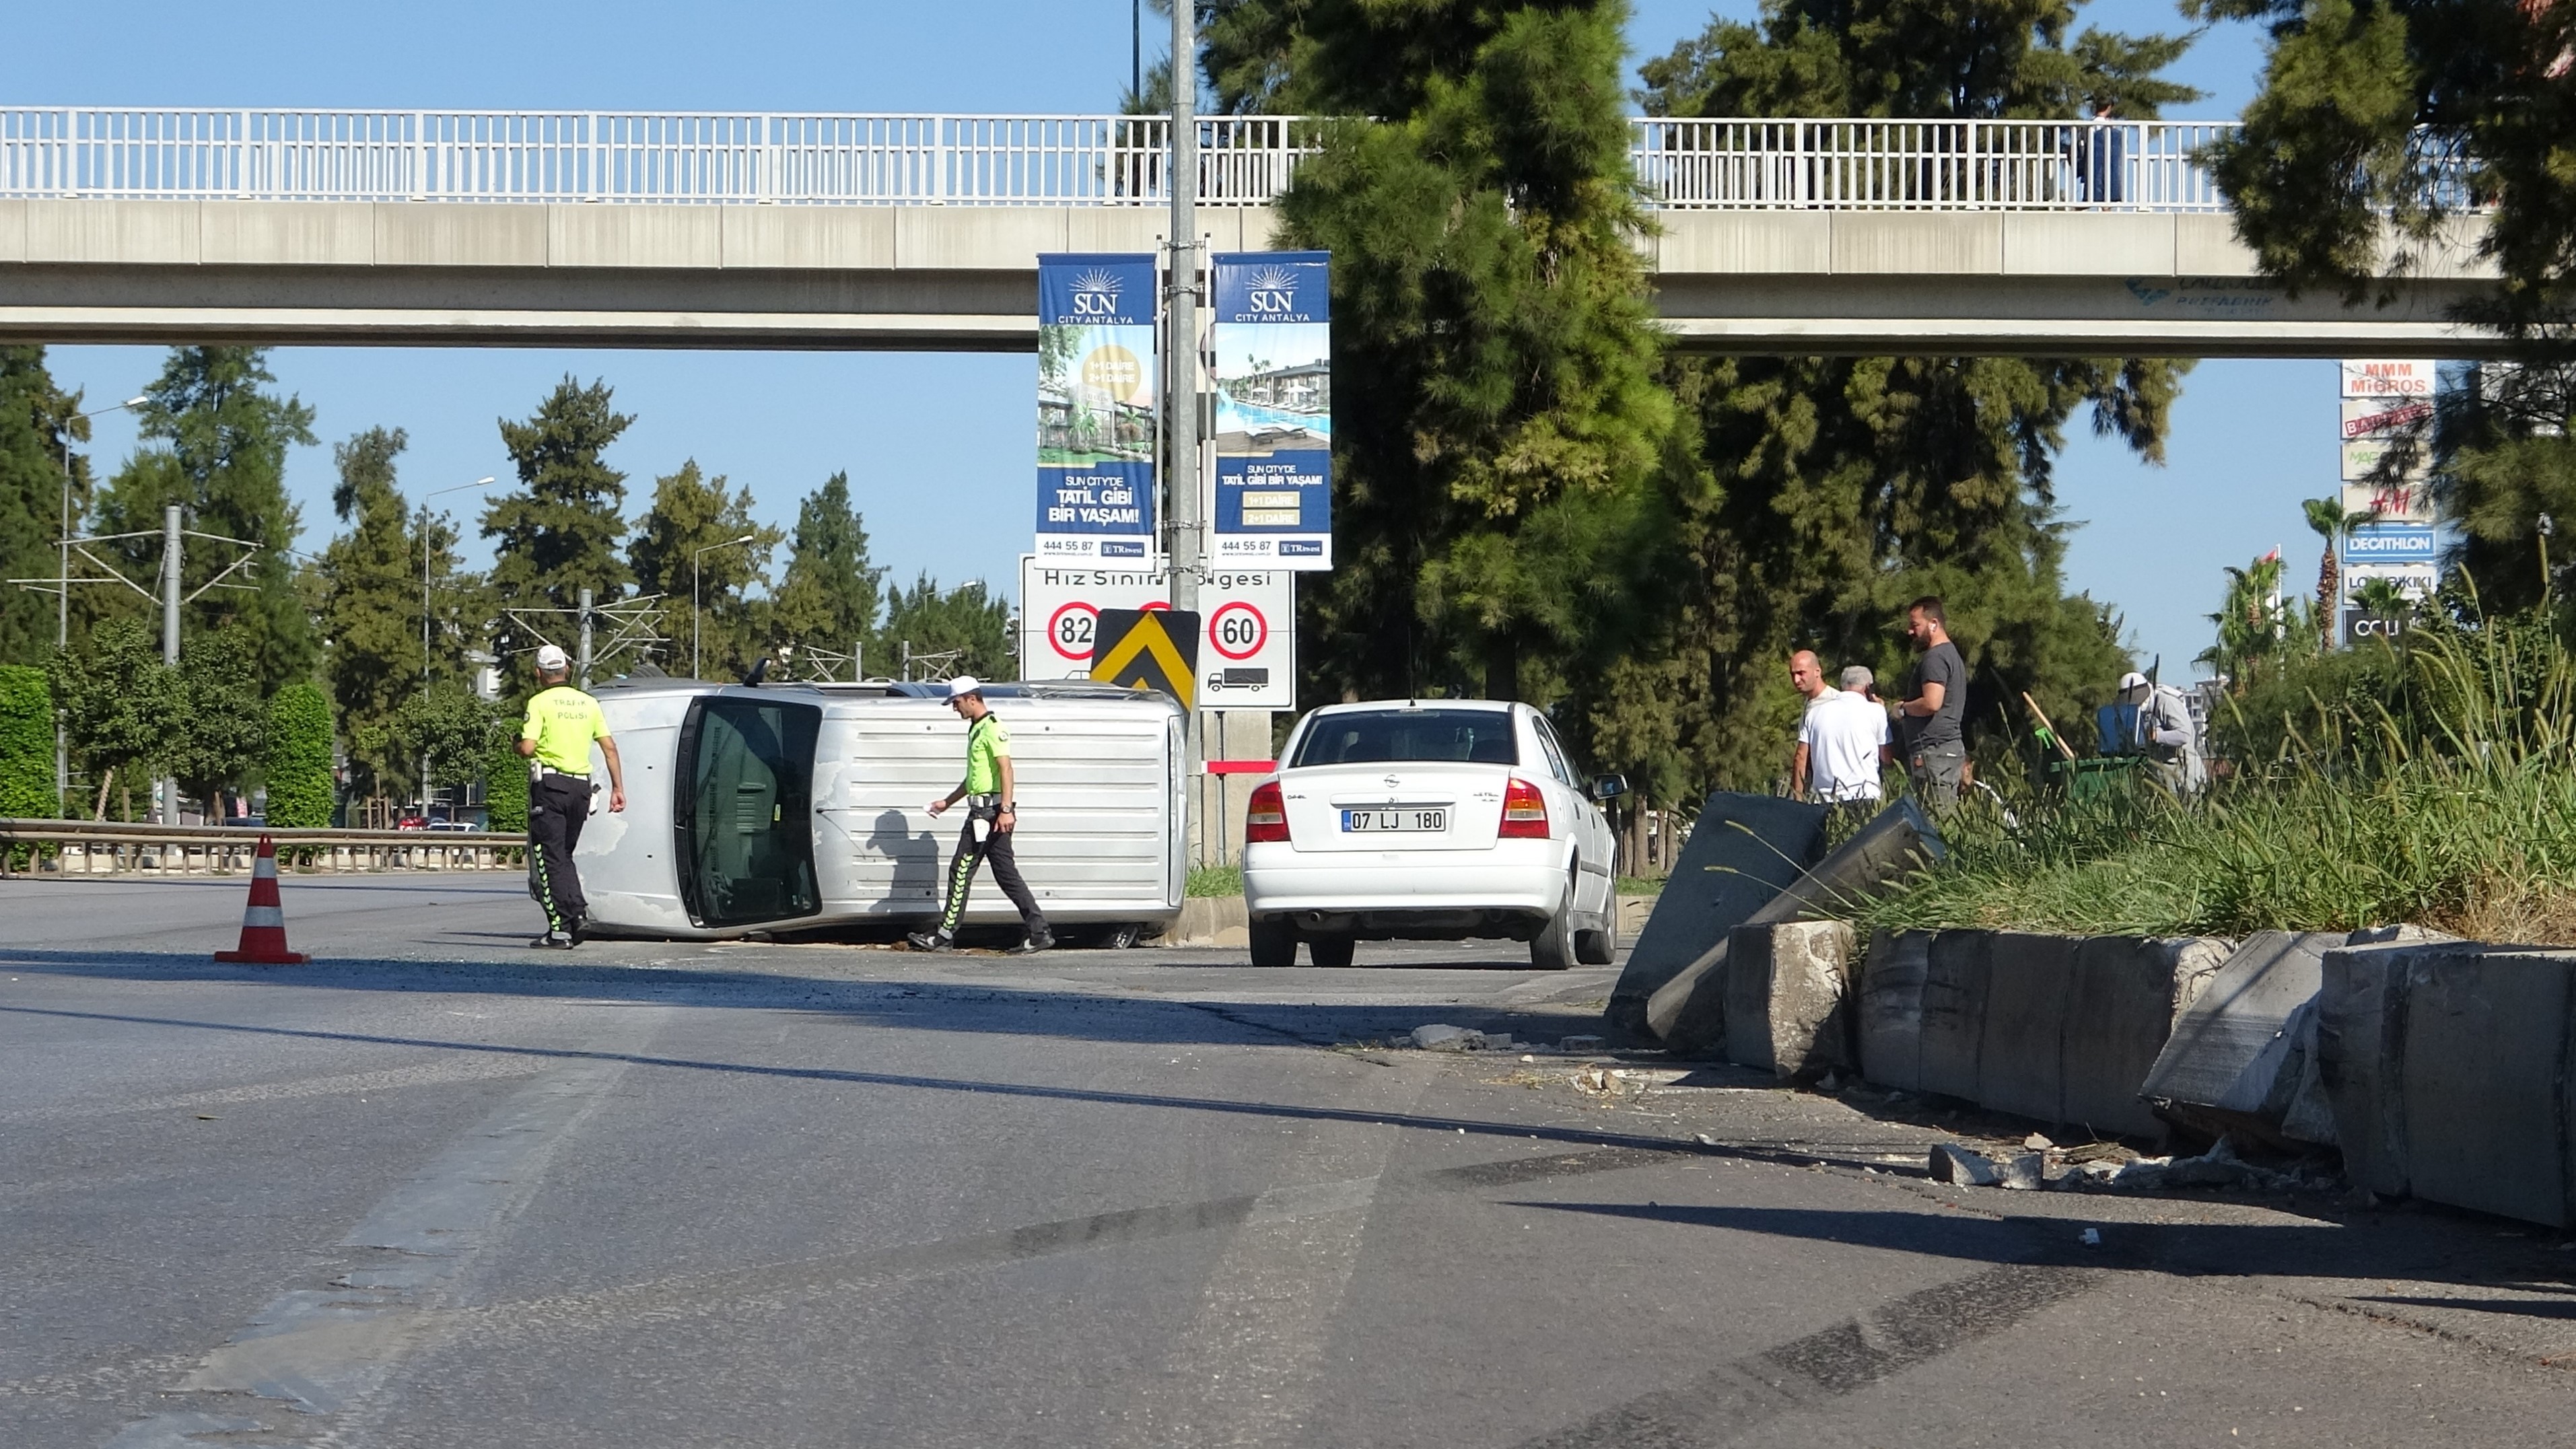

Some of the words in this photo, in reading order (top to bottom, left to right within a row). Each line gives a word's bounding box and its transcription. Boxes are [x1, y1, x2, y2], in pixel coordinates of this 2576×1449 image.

[1074, 293, 1117, 314] SUN
[1251, 291, 1293, 312] SUN
[1058, 316, 1082, 324] CITY
[1085, 316, 1134, 324] ANTALYA
[1235, 314, 1258, 322] CITY
[1262, 314, 1310, 322] ANTALYA
[1090, 361, 1104, 370] 1+1
[2365, 363, 2412, 376] MMM
[1089, 373, 1104, 382] 2+1
[1247, 465, 1264, 473] SUN
[1066, 476, 1086, 486] SUN
[1222, 474, 1245, 485] TATİL
[1247, 474, 1266, 485] GİBİ
[1268, 474, 1284, 485] BİR
[1286, 474, 1323, 487] YAŞAM!
[1056, 486, 1097, 504] TATİL
[1101, 487, 1132, 505] GİBİ
[1249, 496, 1263, 505] 1+1
[1049, 504, 1075, 522] BİR
[1079, 507, 1139, 526] YAŞAM!
[1248, 514, 1264, 523] 2+1
[1044, 541, 1062, 550] 444
[1066, 541, 1078, 551] 55
[1082, 541, 1093, 551] 87
[1222, 541, 1240, 550] 444
[1243, 541, 1256, 551] 55
[1259, 541, 1271, 551] 87
[2349, 536, 2431, 551] DECATHLON
[1045, 570, 1085, 585] Hız
[1061, 617, 1092, 643] 82
[1224, 618, 1253, 644] 60
[1353, 812, 1370, 829] 07
[1381, 812, 1399, 829] LJ
[1416, 812, 1442, 829] 180
